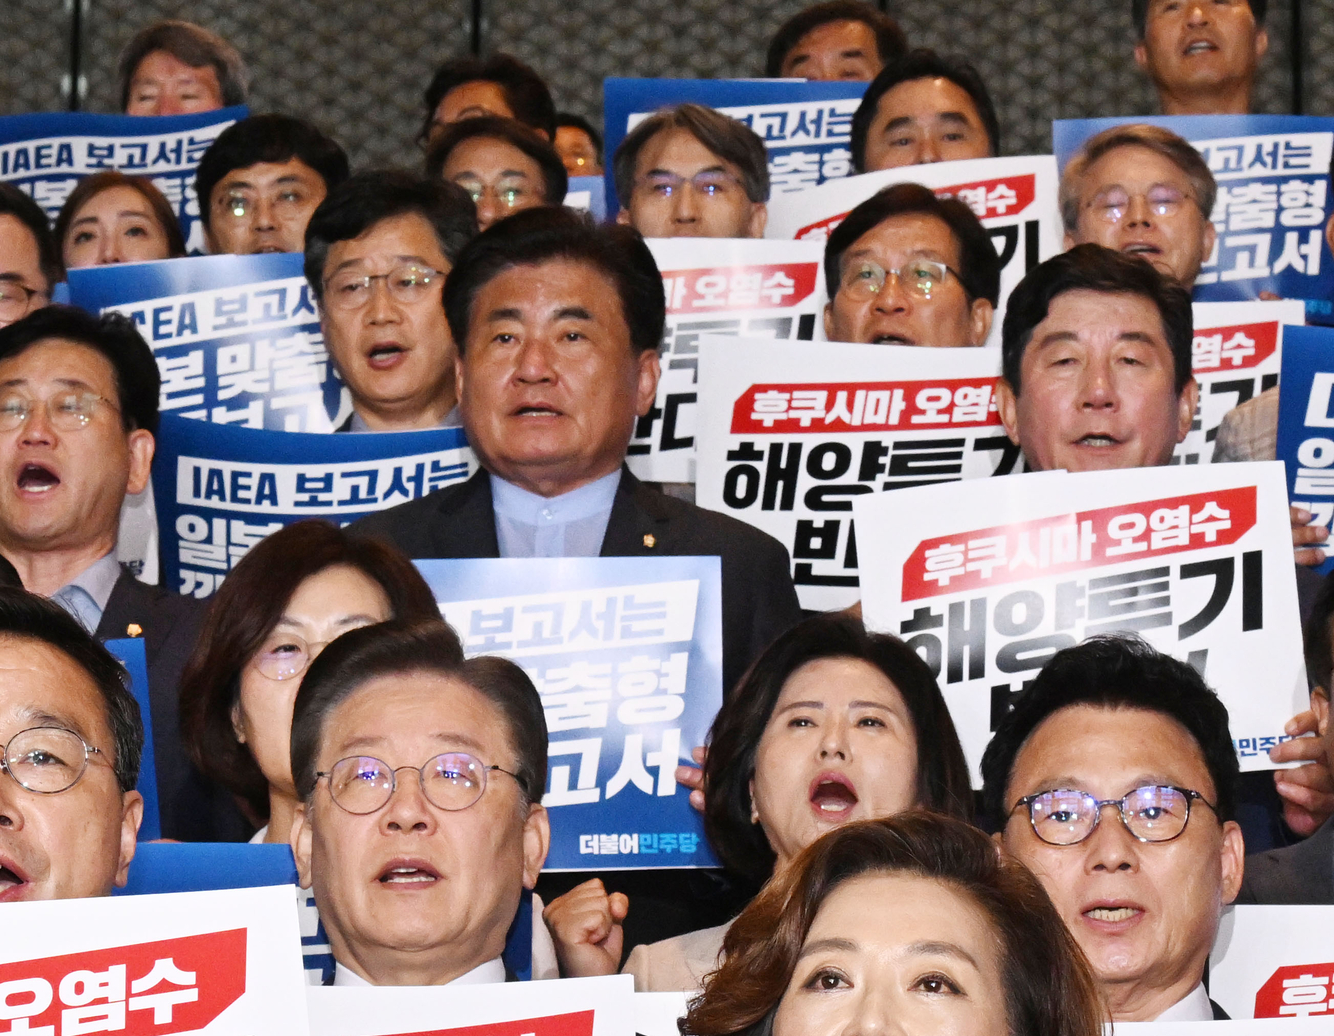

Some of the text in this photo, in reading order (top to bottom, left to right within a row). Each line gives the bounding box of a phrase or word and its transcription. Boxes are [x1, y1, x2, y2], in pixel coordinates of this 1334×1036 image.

[1, 142, 74, 175] IAEA
[1202, 140, 1313, 175] 고서는
[692, 271, 795, 308] 오염수
[217, 332, 330, 401] 맞춤
[1192, 331, 1256, 368] 염수
[750, 385, 998, 428] 후쿠시마 오염
[192, 465, 279, 508] IAEA
[923, 520, 1097, 588] 후쿠시마
[1104, 501, 1232, 558] 오염수
[465, 593, 668, 654] 보고서는
[533, 651, 689, 733] 춤형
[579, 832, 701, 856] 더불어민주당
